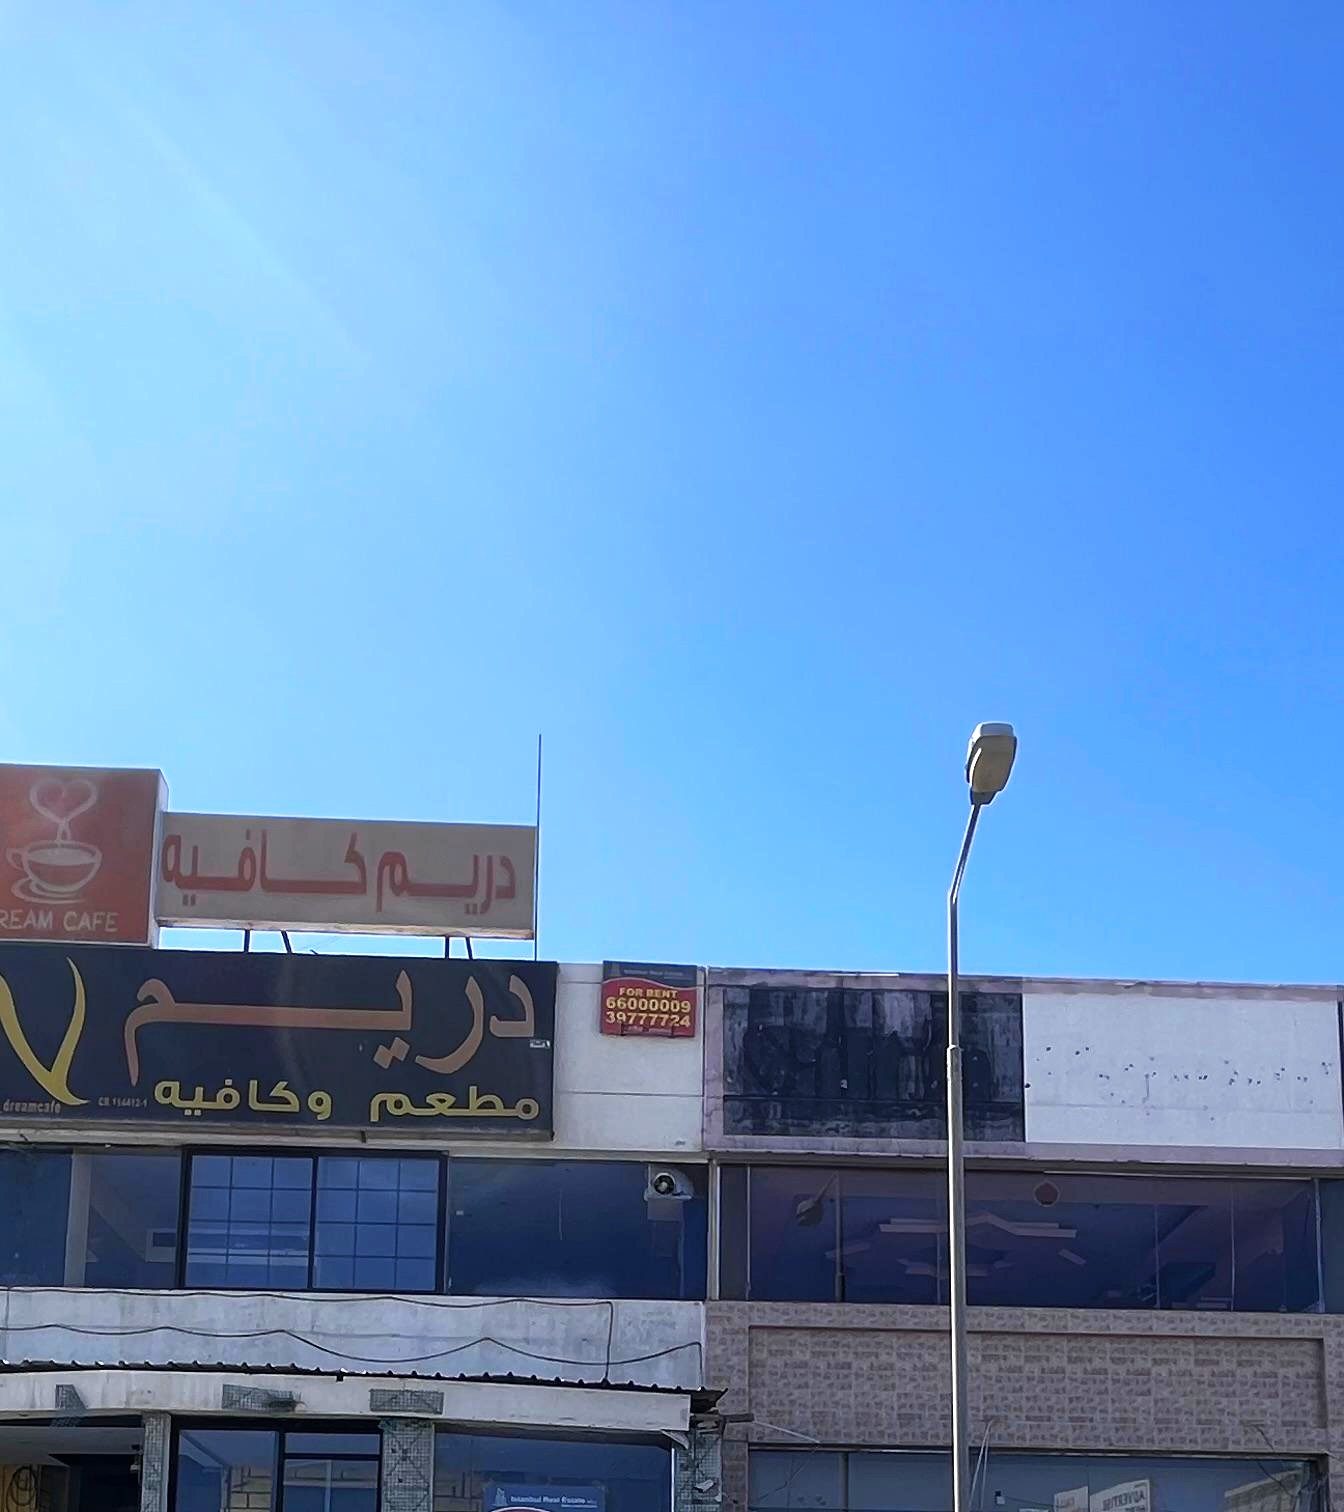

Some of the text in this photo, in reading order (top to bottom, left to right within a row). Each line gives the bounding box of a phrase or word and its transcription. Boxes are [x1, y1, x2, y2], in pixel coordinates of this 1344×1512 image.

[162, 829, 516, 914] دريم كافيه
[63, 911, 119, 932] CAFE
[619, 987, 678, 998] FOR RENT
[606, 997, 691, 1013] 66000009
[123, 969, 535, 1086] دريم
[606, 1011, 691, 1027] 39777724
[154, 1077, 541, 1122] مطعم وكافيه
